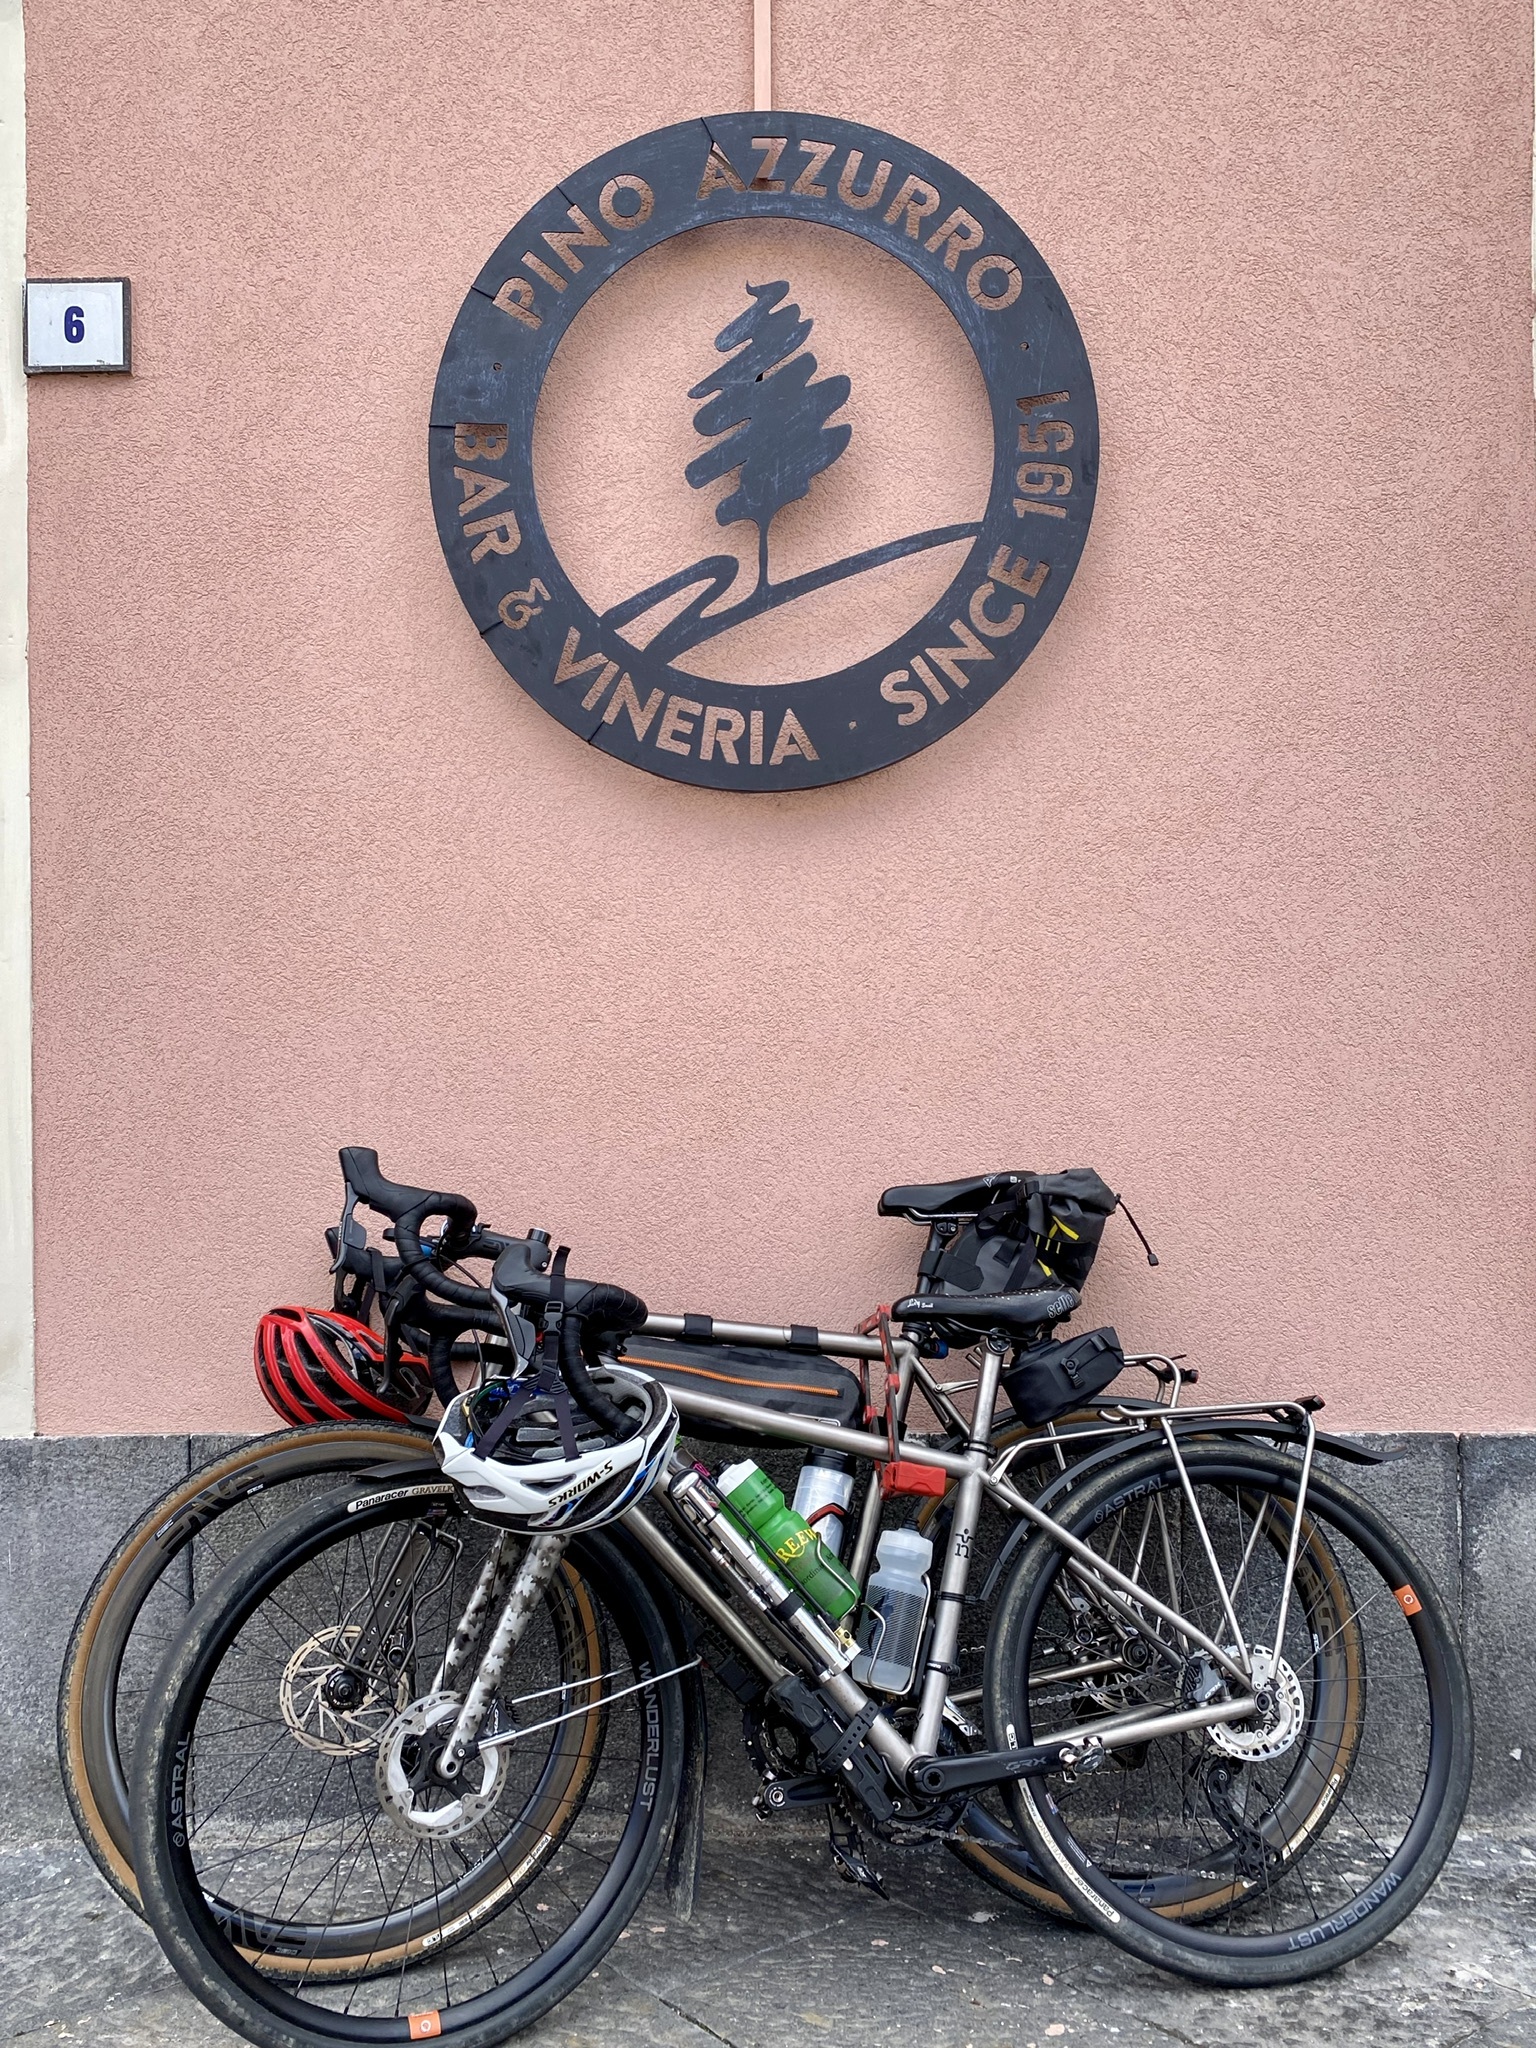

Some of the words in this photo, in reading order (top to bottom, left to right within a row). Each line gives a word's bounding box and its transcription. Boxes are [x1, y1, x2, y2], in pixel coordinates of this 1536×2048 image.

[492, 173, 655, 329] PINO
[696, 135, 1024, 311] AZZURRO
[64, 305, 85, 344] 6
[879, 543, 1052, 726] SINCE
[1012, 390, 1076, 520] 1951
[453, 422, 523, 565] BAR
[497, 577, 552, 631] &
[553, 626, 821, 766] VINERIA
[354, 1488, 410, 1511] Panaracer
[548, 1459, 614, 1509] S-WORKS
[1104, 1476, 1169, 1518] ASTRAL
[638, 1660, 660, 1812] WANDERLUST
[1005, 1755, 1047, 1771] GRX
[171, 1731, 191, 1830] ASTRAL
[1073, 1874, 1115, 1919] Panaracer
[1287, 1872, 1402, 1952] WANDERLUST
